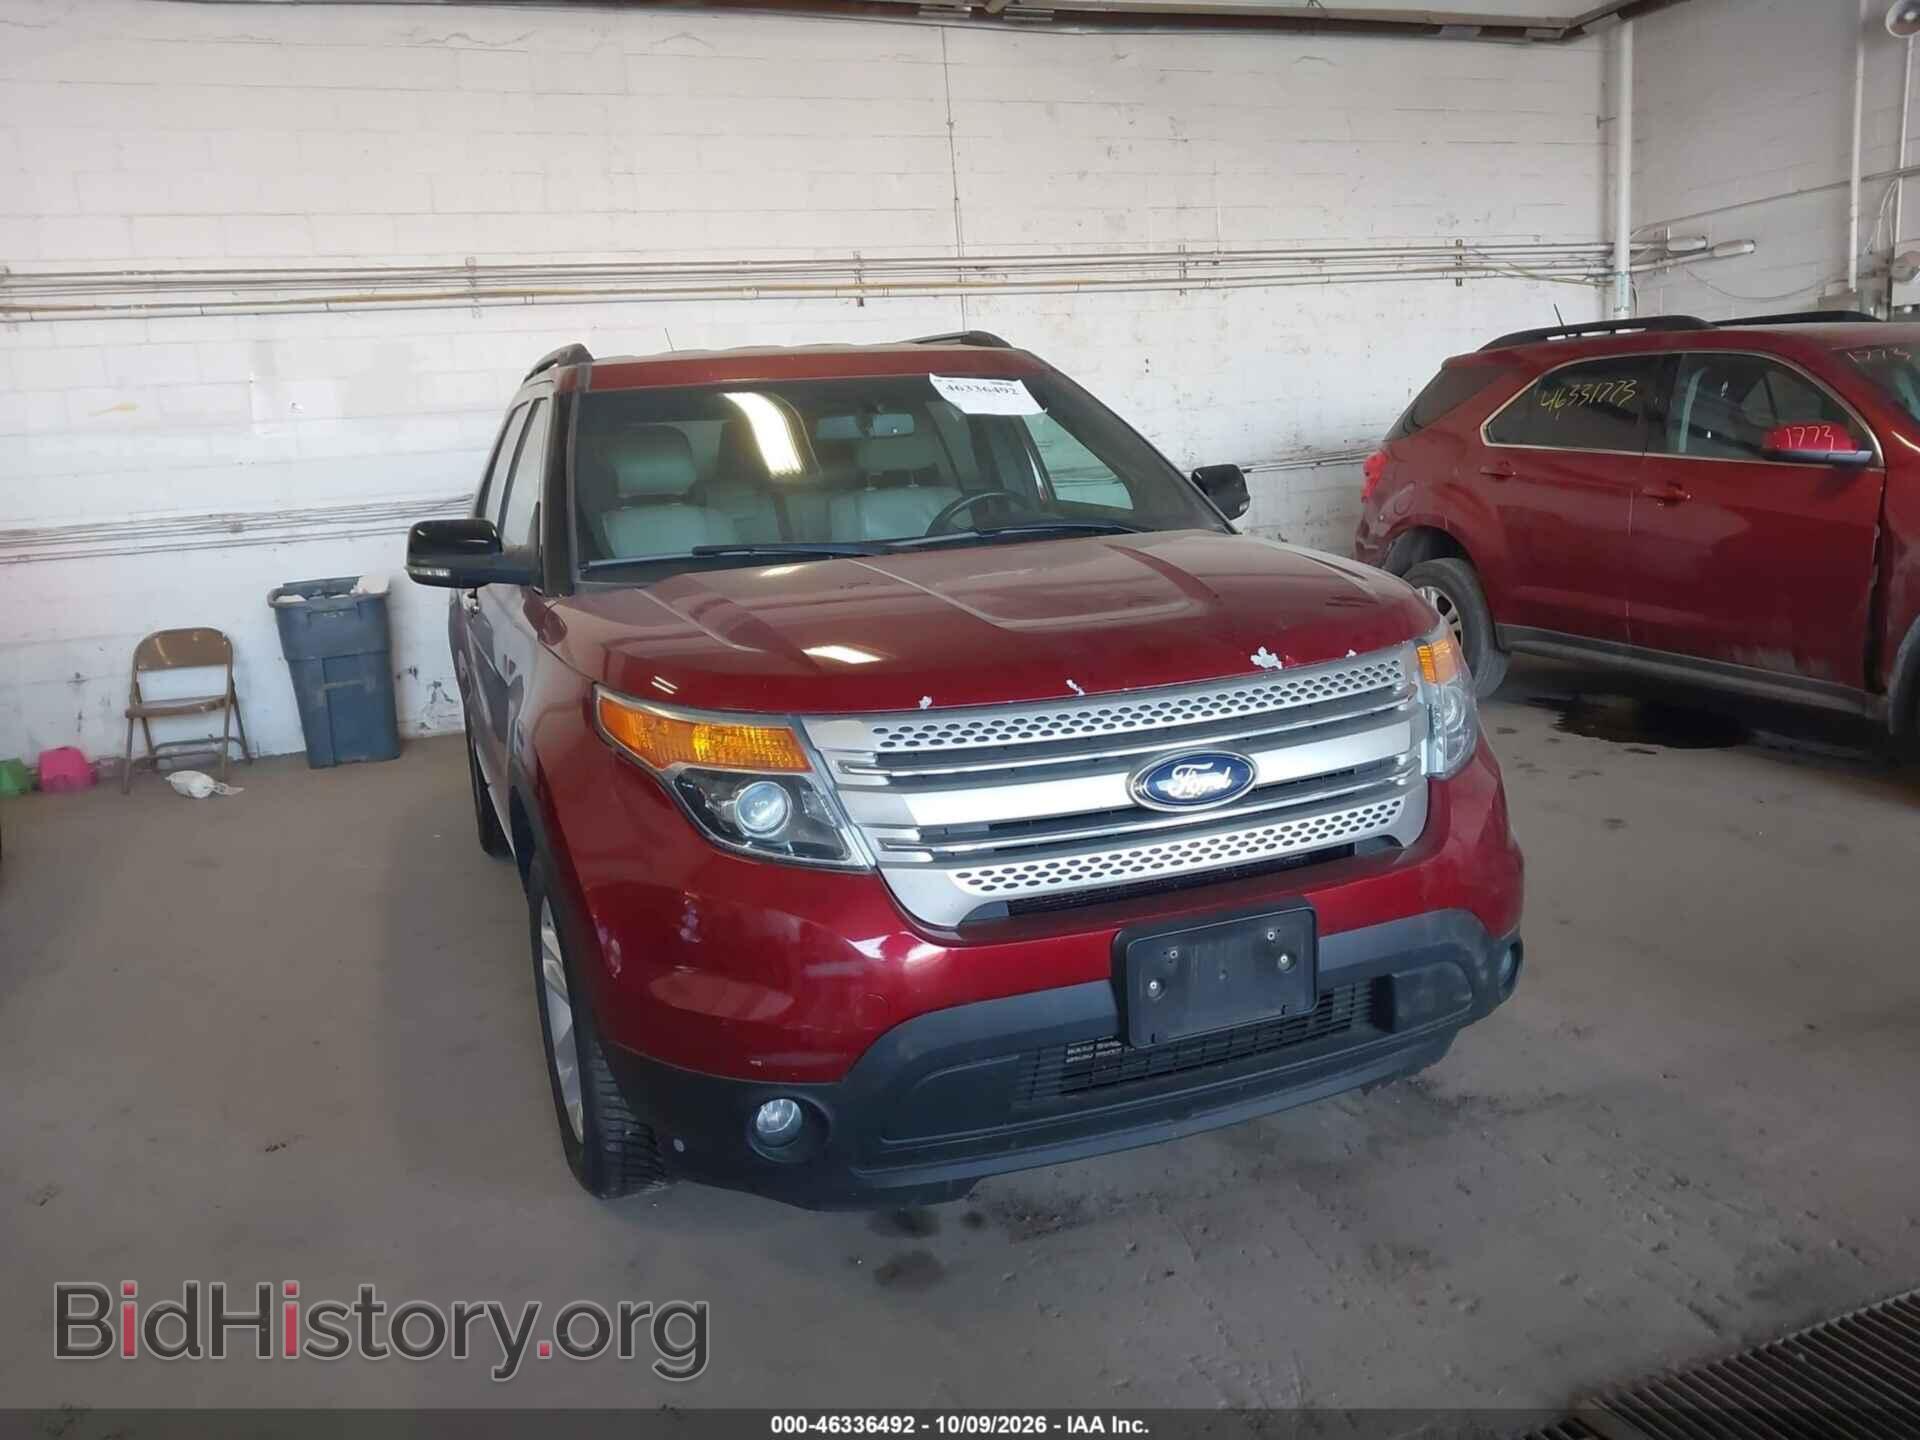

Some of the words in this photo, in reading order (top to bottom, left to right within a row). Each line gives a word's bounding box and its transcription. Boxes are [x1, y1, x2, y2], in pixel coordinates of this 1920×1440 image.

[1540, 379, 1637, 412] 46331773
[1785, 424, 1834, 452] 1773
[1156, 761, 1232, 798] Ford
